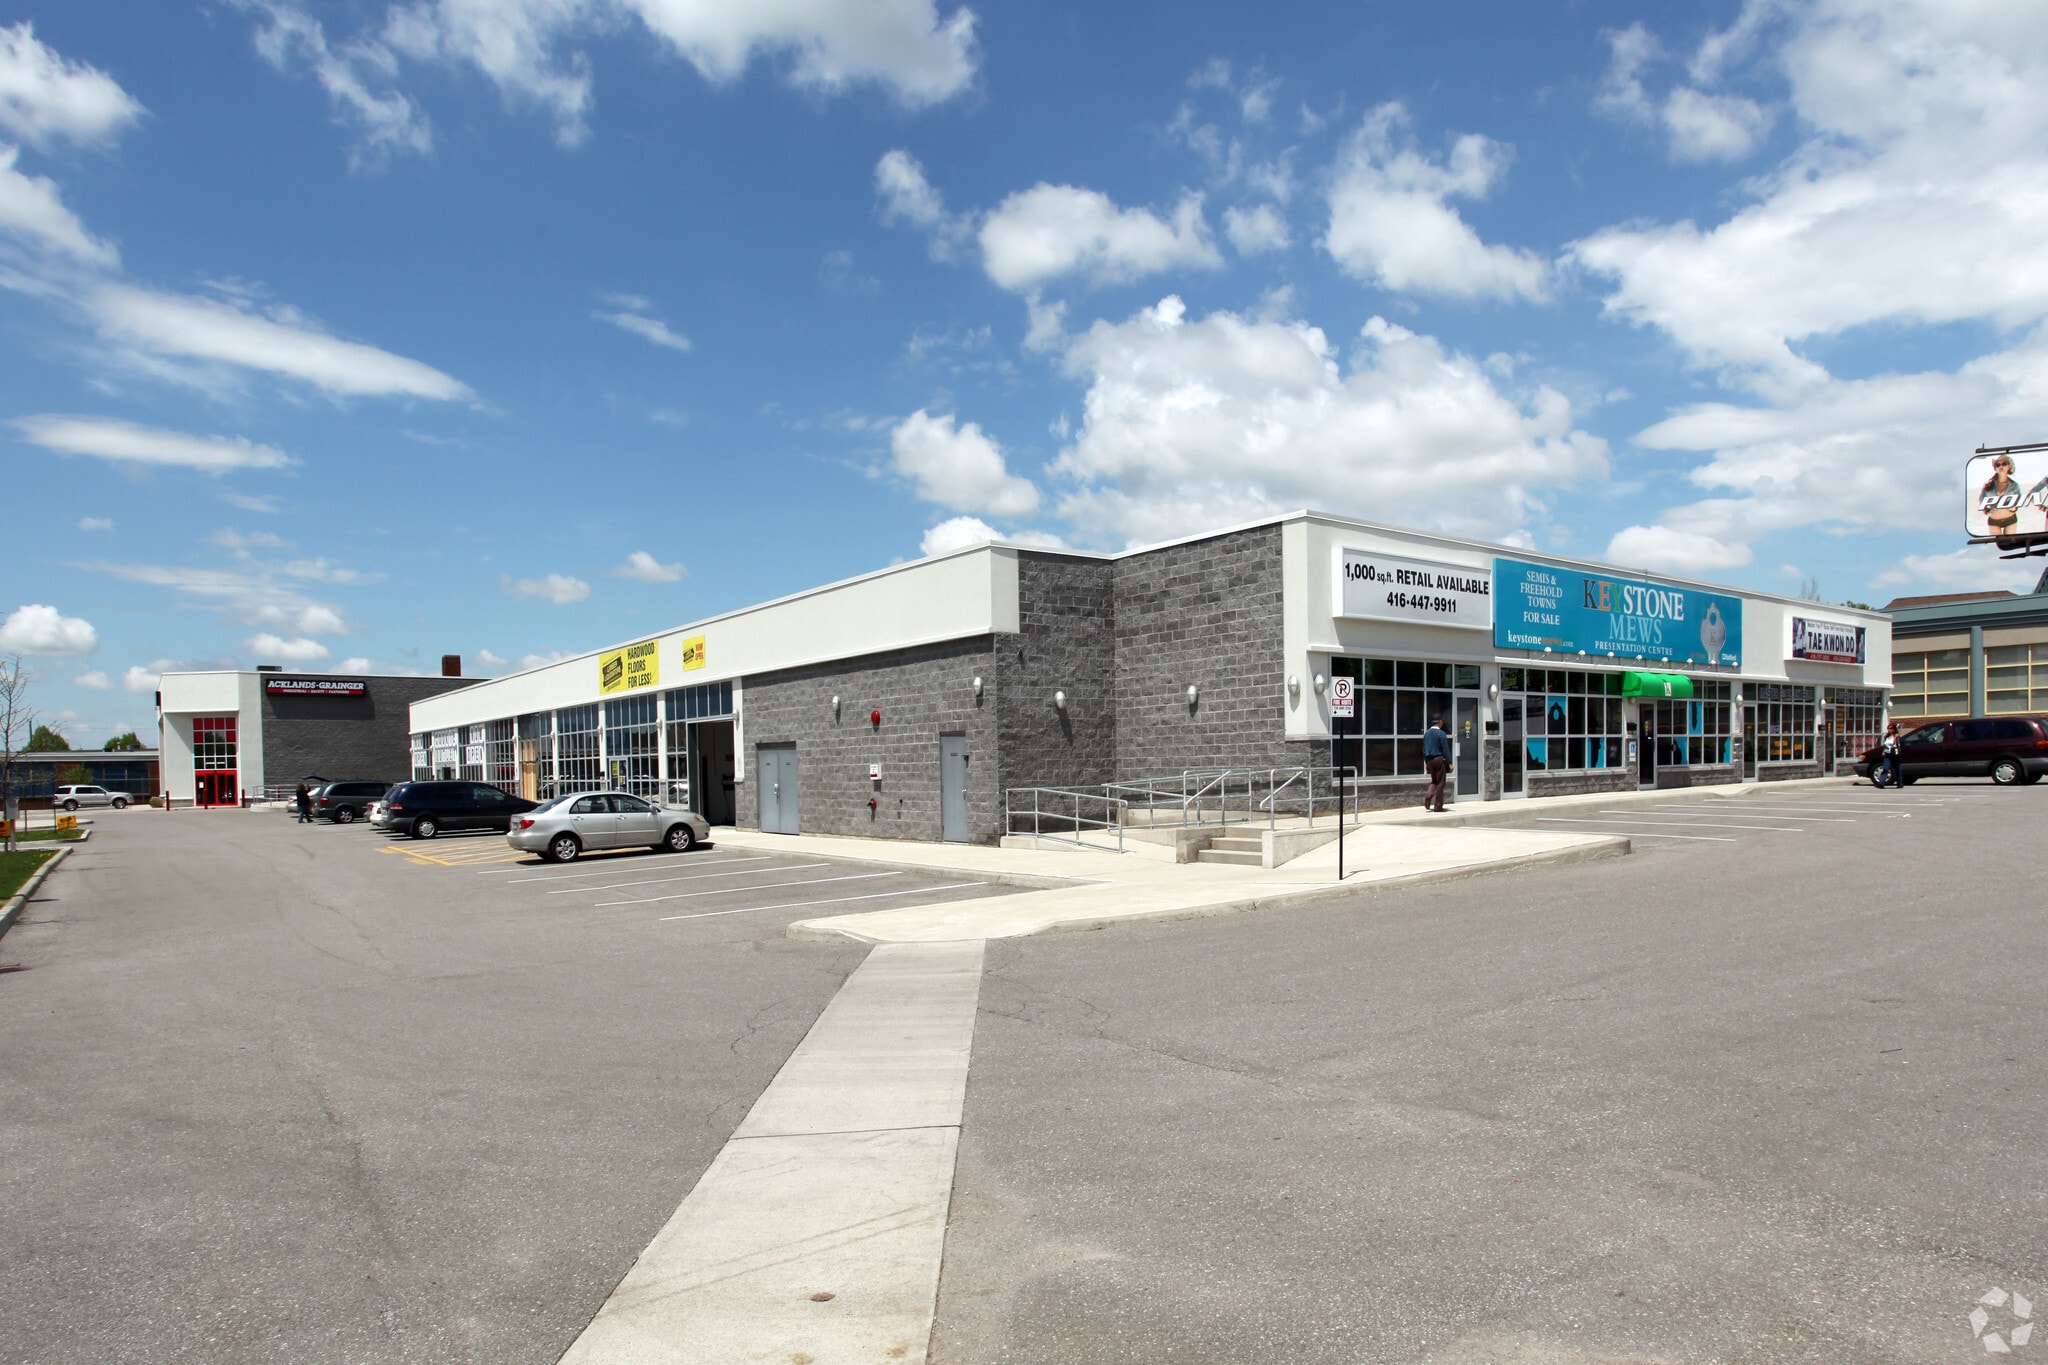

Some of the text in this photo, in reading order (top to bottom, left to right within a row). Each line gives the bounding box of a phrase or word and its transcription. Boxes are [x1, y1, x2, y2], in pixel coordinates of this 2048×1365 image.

[1345, 562, 1376, 581] 1,000
[1396, 569, 1434, 588] RETAIL
[1436, 574, 1489, 595] AVAILABLE
[1526, 570, 1557, 585] SEMIS &
[1520, 582, 1563, 599] FREEHOLD
[1386, 591, 1457, 613] 416-447-9911
[1528, 595, 1557, 610] TOWNS
[1582, 578, 1684, 621] KEYSTONE
[1523, 611, 1560, 626] FOR SALE
[1608, 613, 1663, 644] MEWS
[1508, 630, 1574, 648] keystonemews.com
[1808, 631, 1855, 653] TAE KWON DO
[627, 642, 655, 660] HARDWOOD
[1594, 640, 1673, 656] PRESENTATION CENTRE
[628, 659, 646, 675] FLOORS
[267, 680, 364, 690] ACKLANDS-GRAINGER
[628, 672, 652, 689] FOR LESS!
